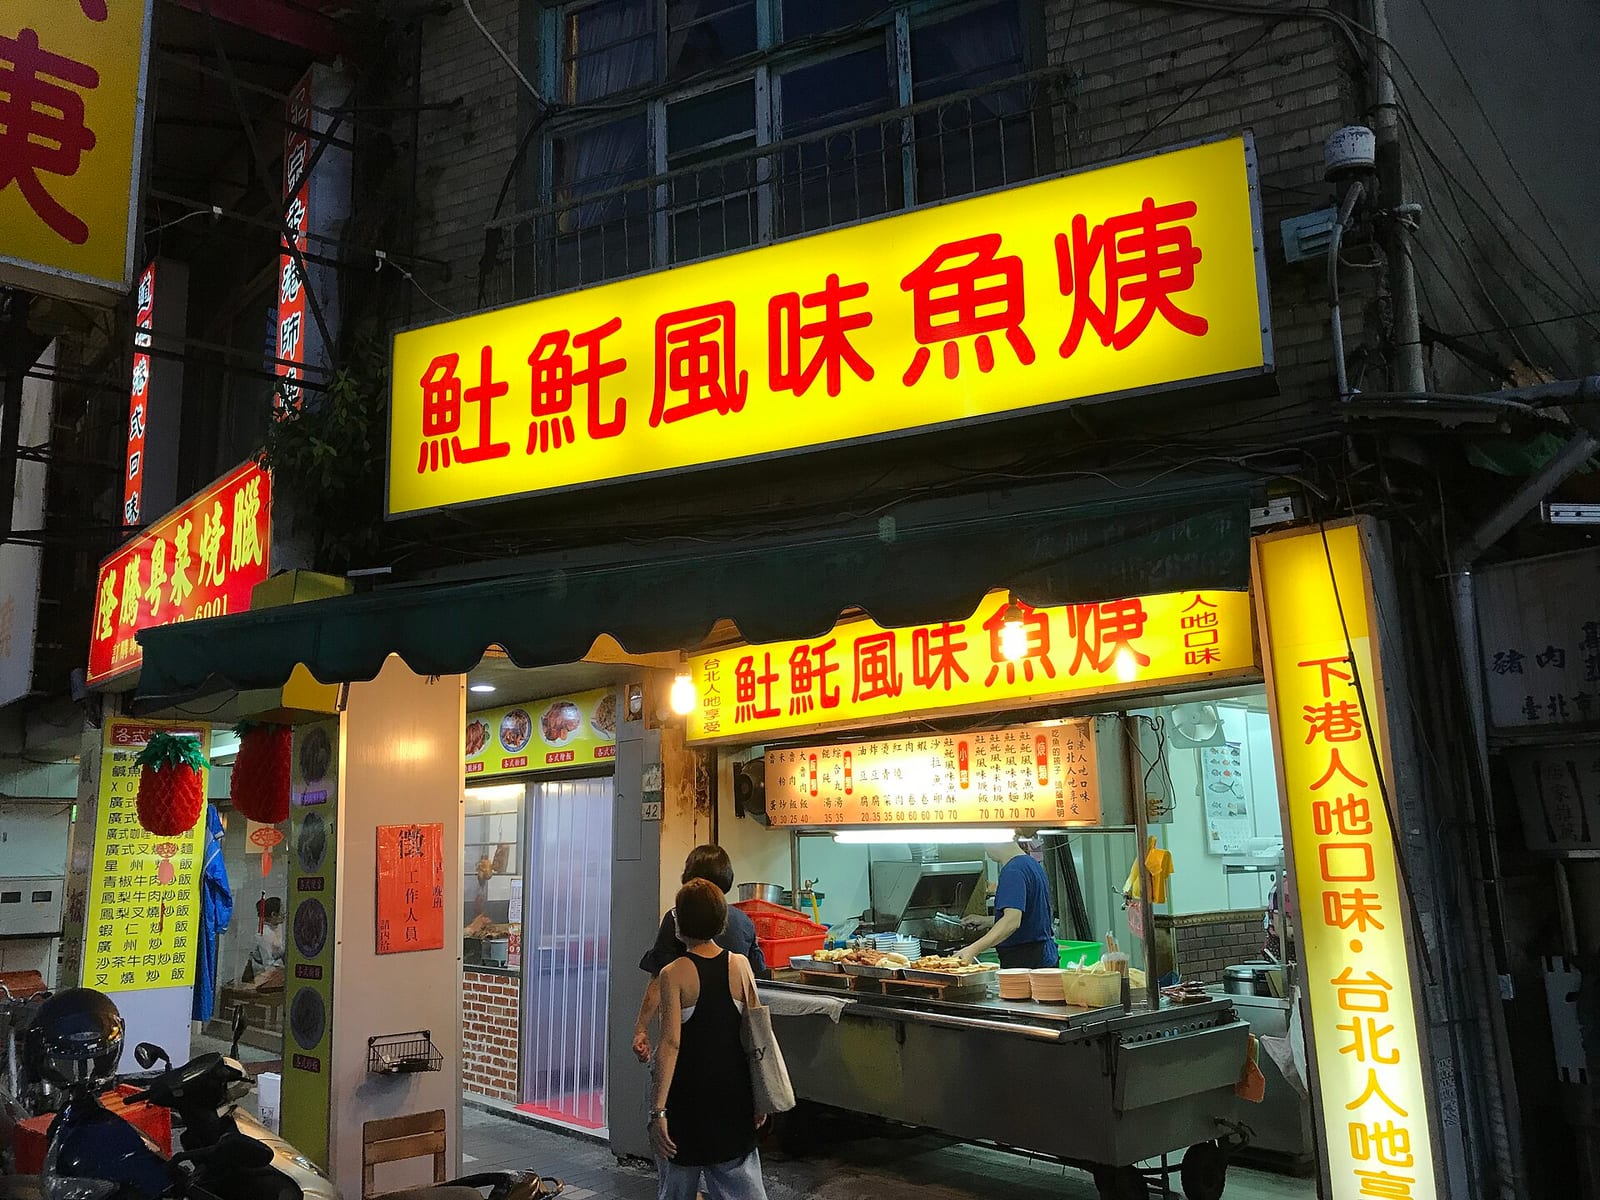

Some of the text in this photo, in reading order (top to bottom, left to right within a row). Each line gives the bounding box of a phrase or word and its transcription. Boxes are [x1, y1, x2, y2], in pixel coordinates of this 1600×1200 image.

[645, 804, 658, 818] 42
[884, 811, 893, 821] 35
[895, 811, 905, 821] 60
[908, 811, 918, 821] 60
[921, 810, 931, 821] 60
[934, 810, 945, 820] 70
[948, 809, 959, 820] 70
[979, 808, 990, 820] 70
[994, 808, 1005, 819] 70
[1009, 808, 1020, 819] 70
[1024, 807, 1035, 819] 70
[789, 814, 798, 824] 25
[800, 814, 809, 823] 40
[824, 813, 833, 823] 35
[835, 813, 844, 823] 35
[861, 812, 870, 822] 20
[872, 812, 881, 822] 35
[104, 860, 193, 873] 星州飯
[404, 871, 420, 942] 工作人員
[97, 937, 187, 953] 廣州炒飯
[95, 953, 186, 969] 沙茶牛肉炒飯
[94, 969, 185, 986] 叉燒炒飯
